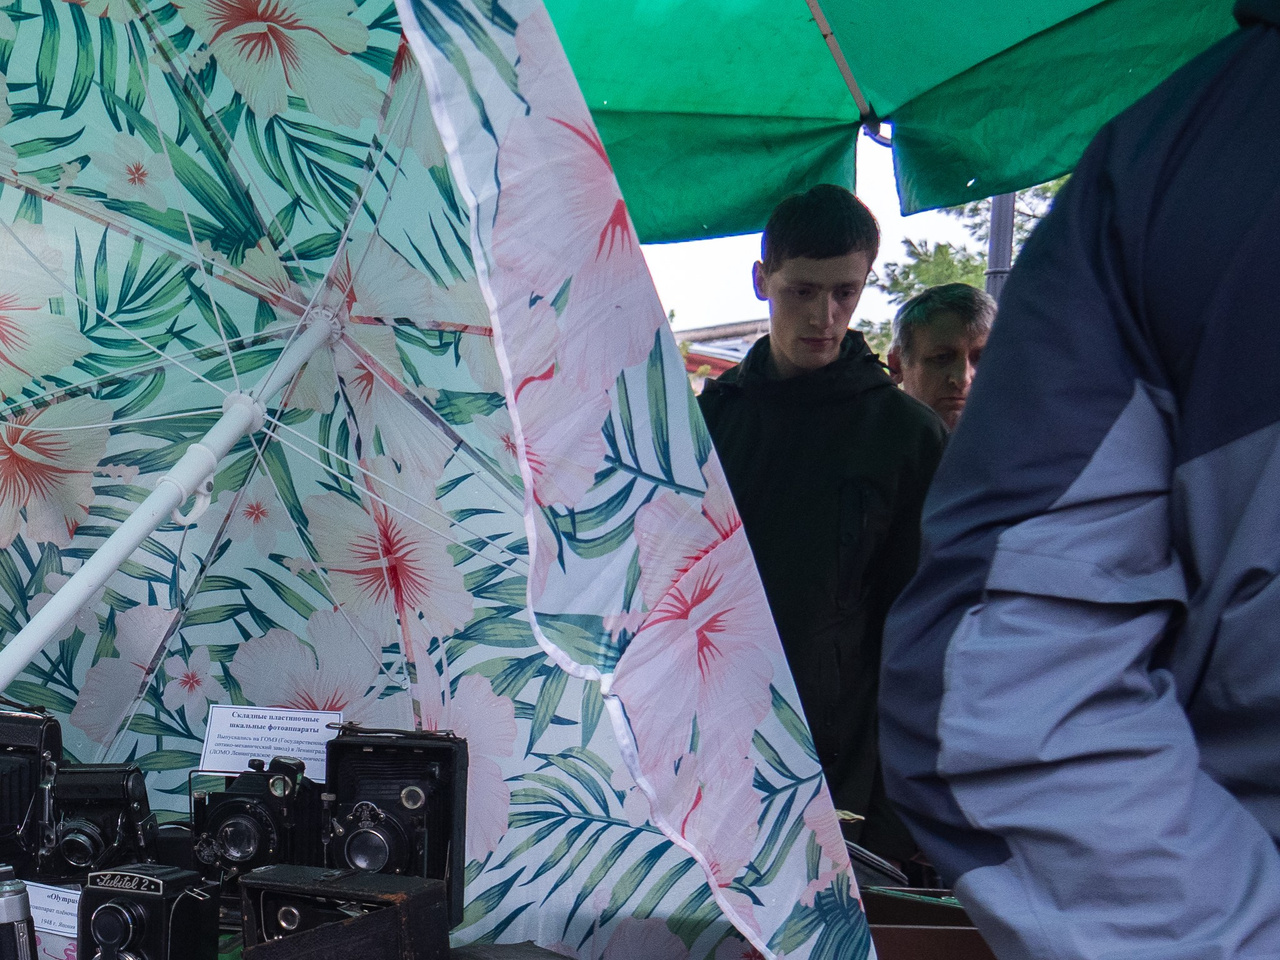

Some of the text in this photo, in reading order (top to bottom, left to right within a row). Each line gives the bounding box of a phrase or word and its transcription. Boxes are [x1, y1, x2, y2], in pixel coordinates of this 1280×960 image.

[231, 711, 320, 723] Складные пластиночные
[229, 722, 320, 734] шкальные фотоаппараты
[99, 873, 150, 891] Lubitel 2
